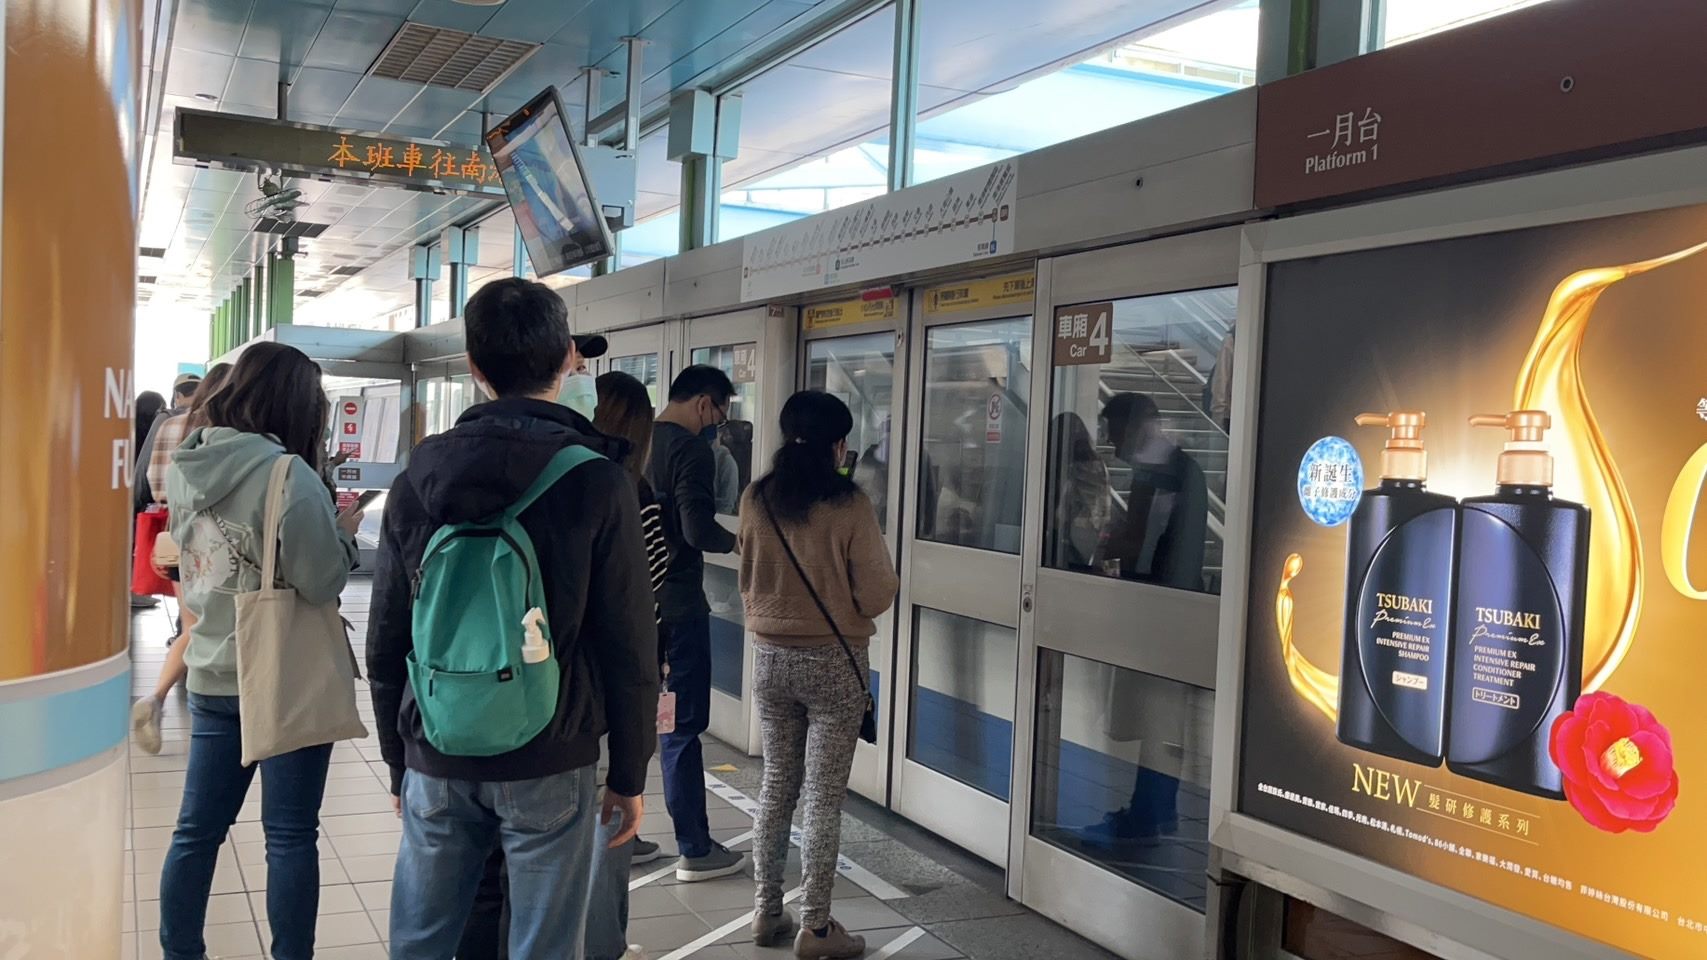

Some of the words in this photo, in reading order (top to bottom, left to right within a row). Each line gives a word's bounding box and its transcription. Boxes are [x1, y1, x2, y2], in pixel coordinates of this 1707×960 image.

[1307, 107, 1381, 150] 一月台
[328, 136, 502, 185] 本班車往南
[1305, 151, 1366, 174] Platform
[1370, 143, 1378, 161] 1
[1058, 313, 1088, 339] 車廂
[1089, 311, 1109, 356] 4
[1070, 343, 1087, 358] Car
[747, 348, 755, 378] 4
[1310, 463, 1352, 482] 新誕生
[1376, 593, 1433, 614] TSUBAKI
[1476, 607, 1541, 630] TSUBAKI
[1376, 637, 1407, 649] INTENSIVE
[1408, 643, 1430, 653] REPAIR
[1392, 631, 1421, 643] PREMIUM
[1421, 636, 1430, 644] EX
[1398, 650, 1430, 662] SHAMPOO
[1474, 645, 1506, 658] PREMIUM
[1507, 651, 1517, 659] EX
[1473, 664, 1522, 679] CONDITIONER
[1474, 655, 1509, 668] INTENSIVE
[1510, 660, 1536, 672] REPAIR
[1473, 673, 1515, 688] TREATMENT
[1474, 690, 1516, 706] トリートメント
[1352, 763, 1422, 808] NEW
[1428, 792, 1530, 837] 髮研修護系列
